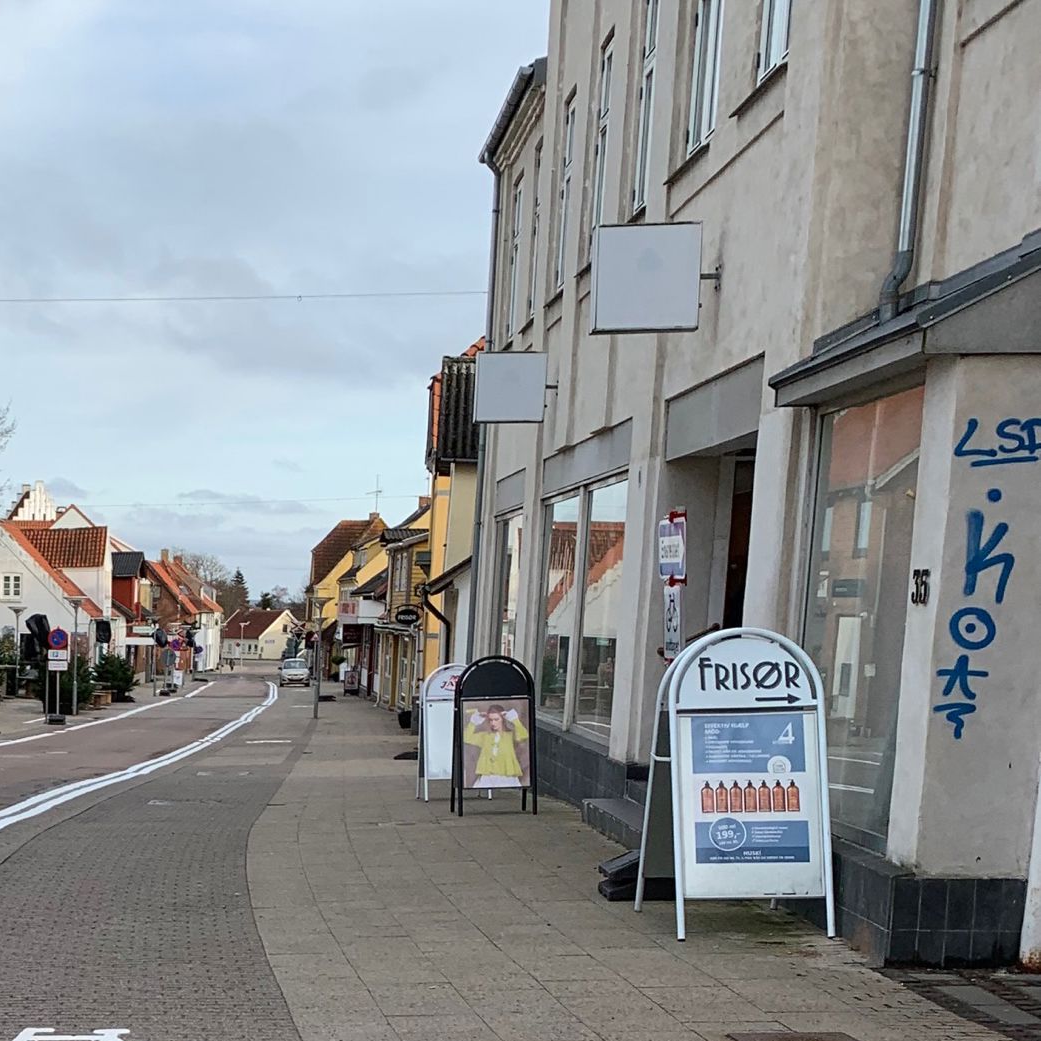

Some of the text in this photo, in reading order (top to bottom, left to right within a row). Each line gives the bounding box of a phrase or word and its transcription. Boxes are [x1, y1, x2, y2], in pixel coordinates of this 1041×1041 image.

[911, 569, 930, 606] 35
[698, 657, 801, 691] FRISØR
[716, 830, 741, 840] 199,-
